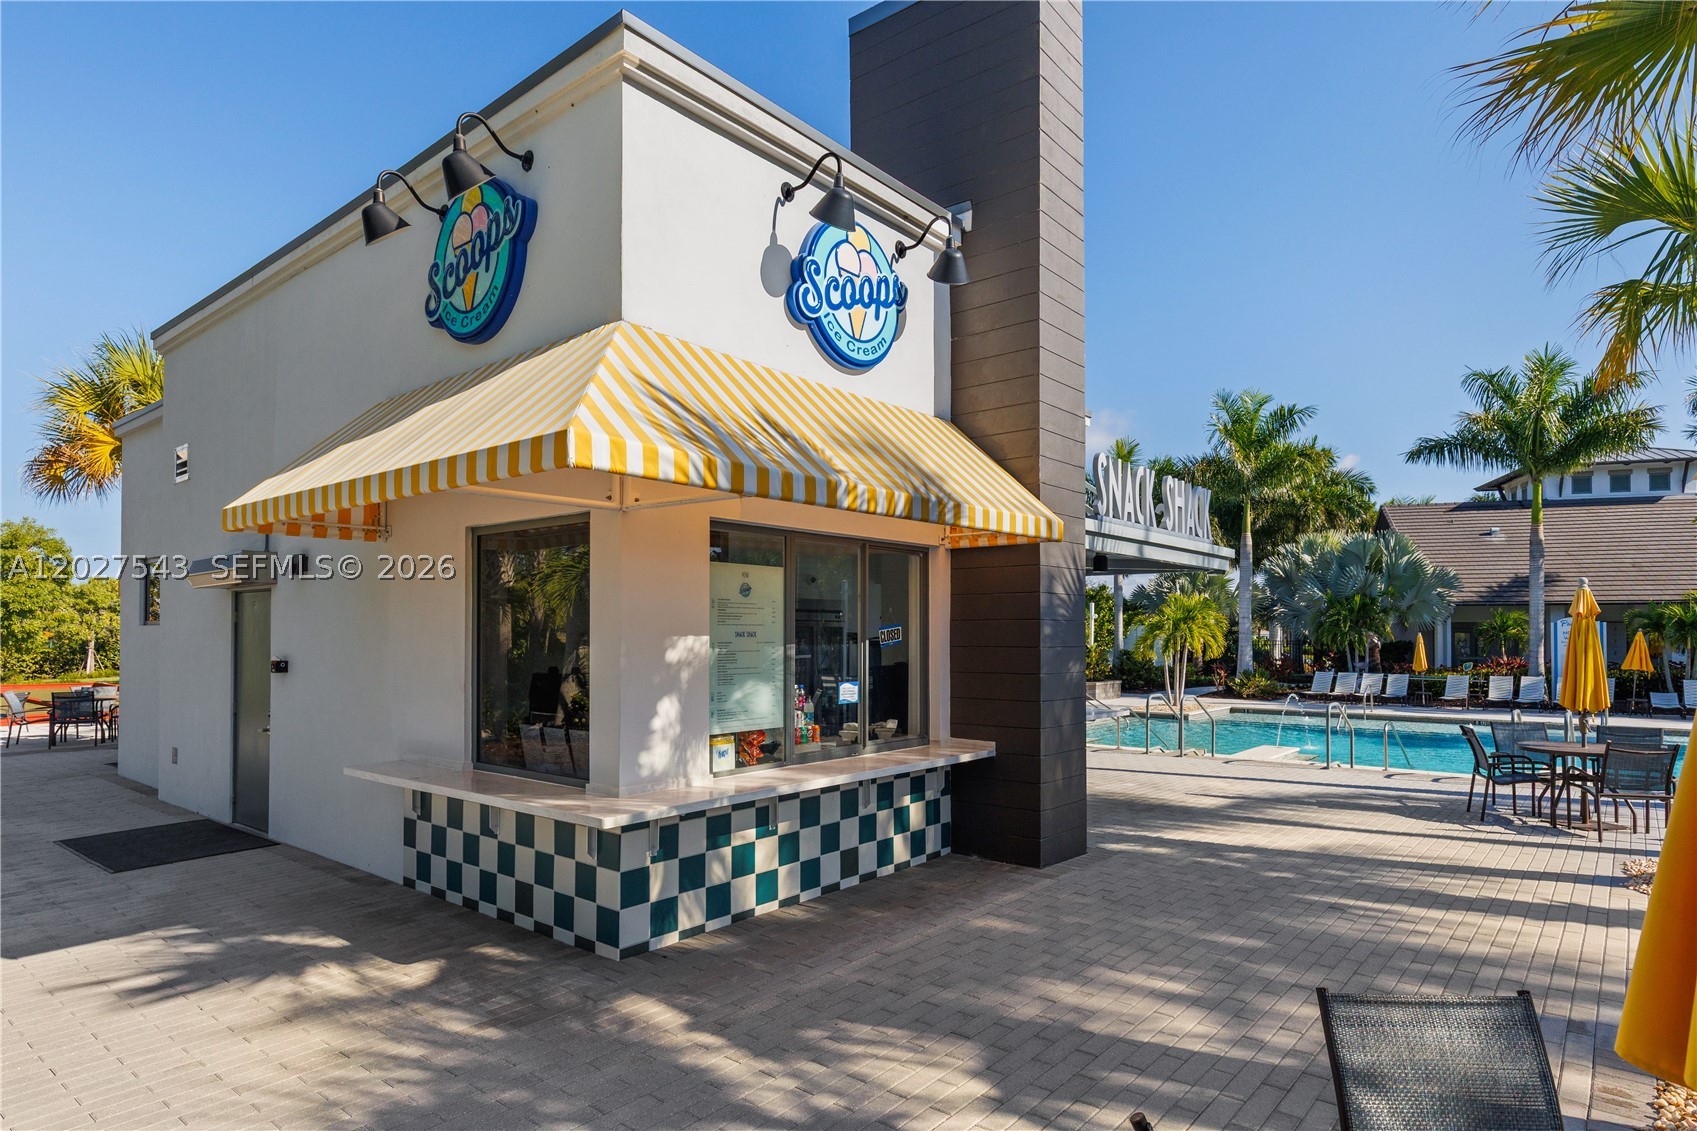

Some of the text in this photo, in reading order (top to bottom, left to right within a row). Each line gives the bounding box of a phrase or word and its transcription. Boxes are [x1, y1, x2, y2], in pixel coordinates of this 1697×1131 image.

[425, 196, 521, 318] Scoops
[442, 286, 499, 328] Ice Cream
[801, 257, 907, 321] Scoops
[823, 311, 887, 356] Ice Cream
[1093, 452, 1213, 540] SNACK SHACK
[880, 627, 900, 643] CLOSED
